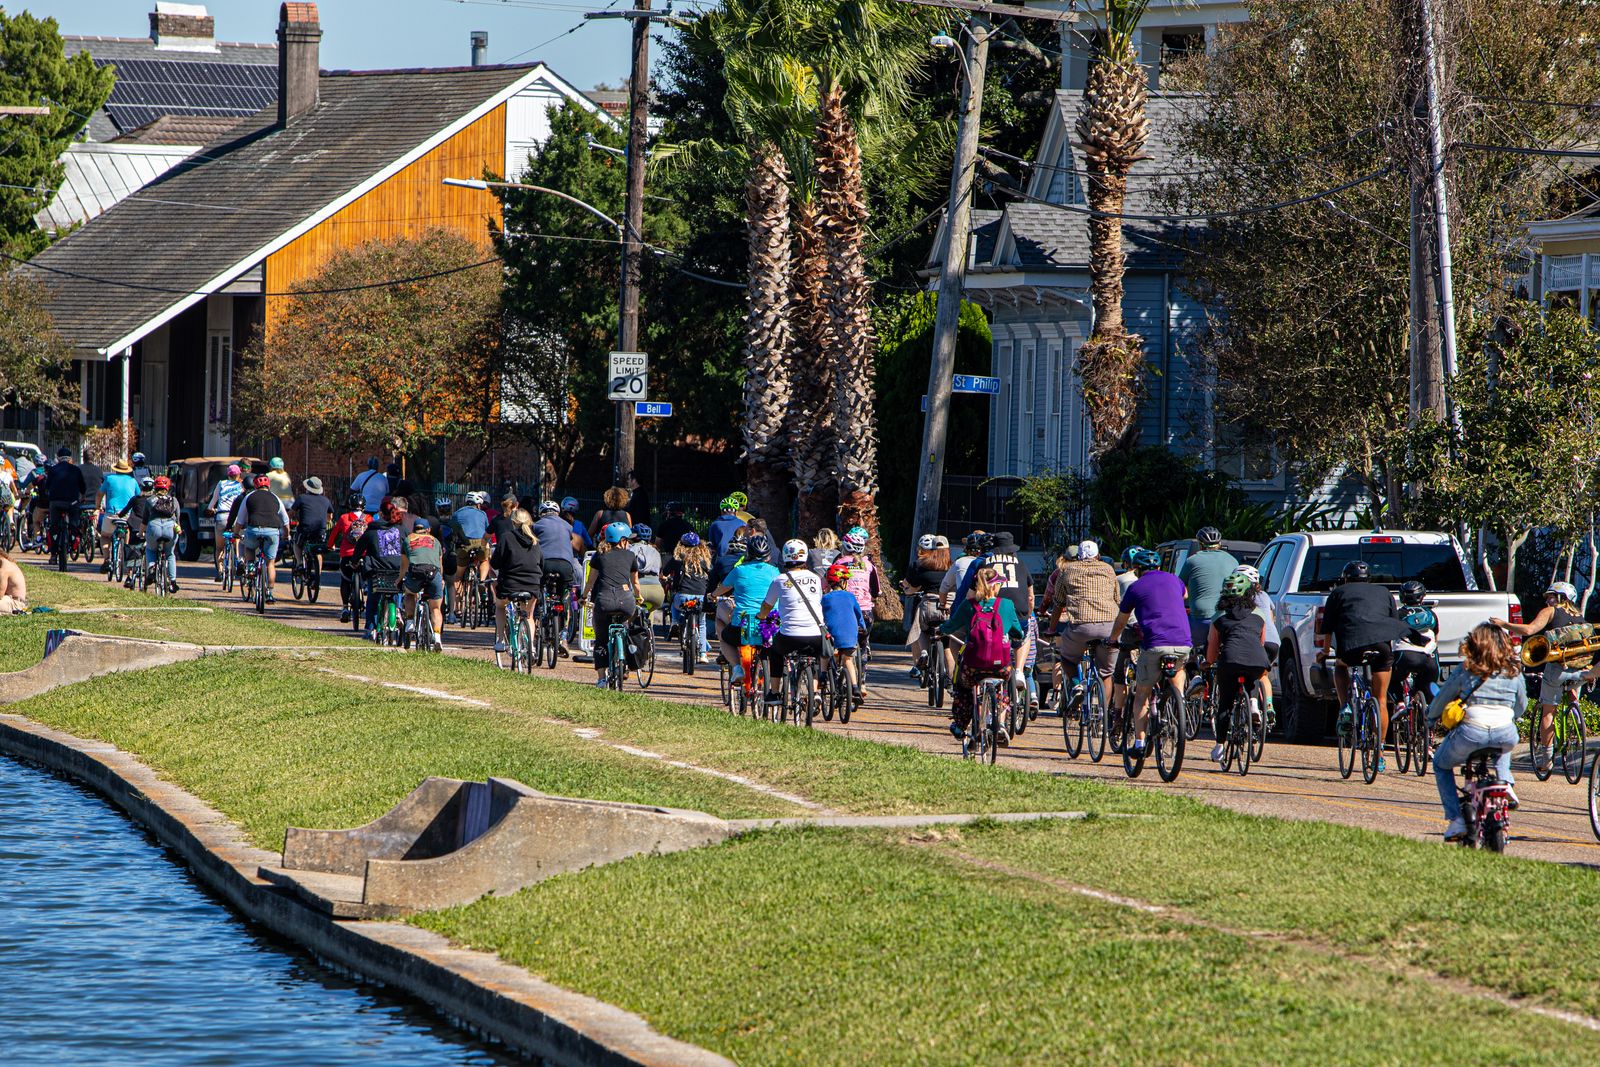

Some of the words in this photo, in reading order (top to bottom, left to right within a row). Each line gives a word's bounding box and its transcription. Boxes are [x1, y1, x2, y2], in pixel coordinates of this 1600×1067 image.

[613, 357, 644, 366] SPEED
[616, 367, 640, 375] LIMIT
[613, 376, 643, 394] 20
[955, 376, 966, 388] St
[973, 377, 999, 392] Philip
[646, 404, 661, 414] Bell
